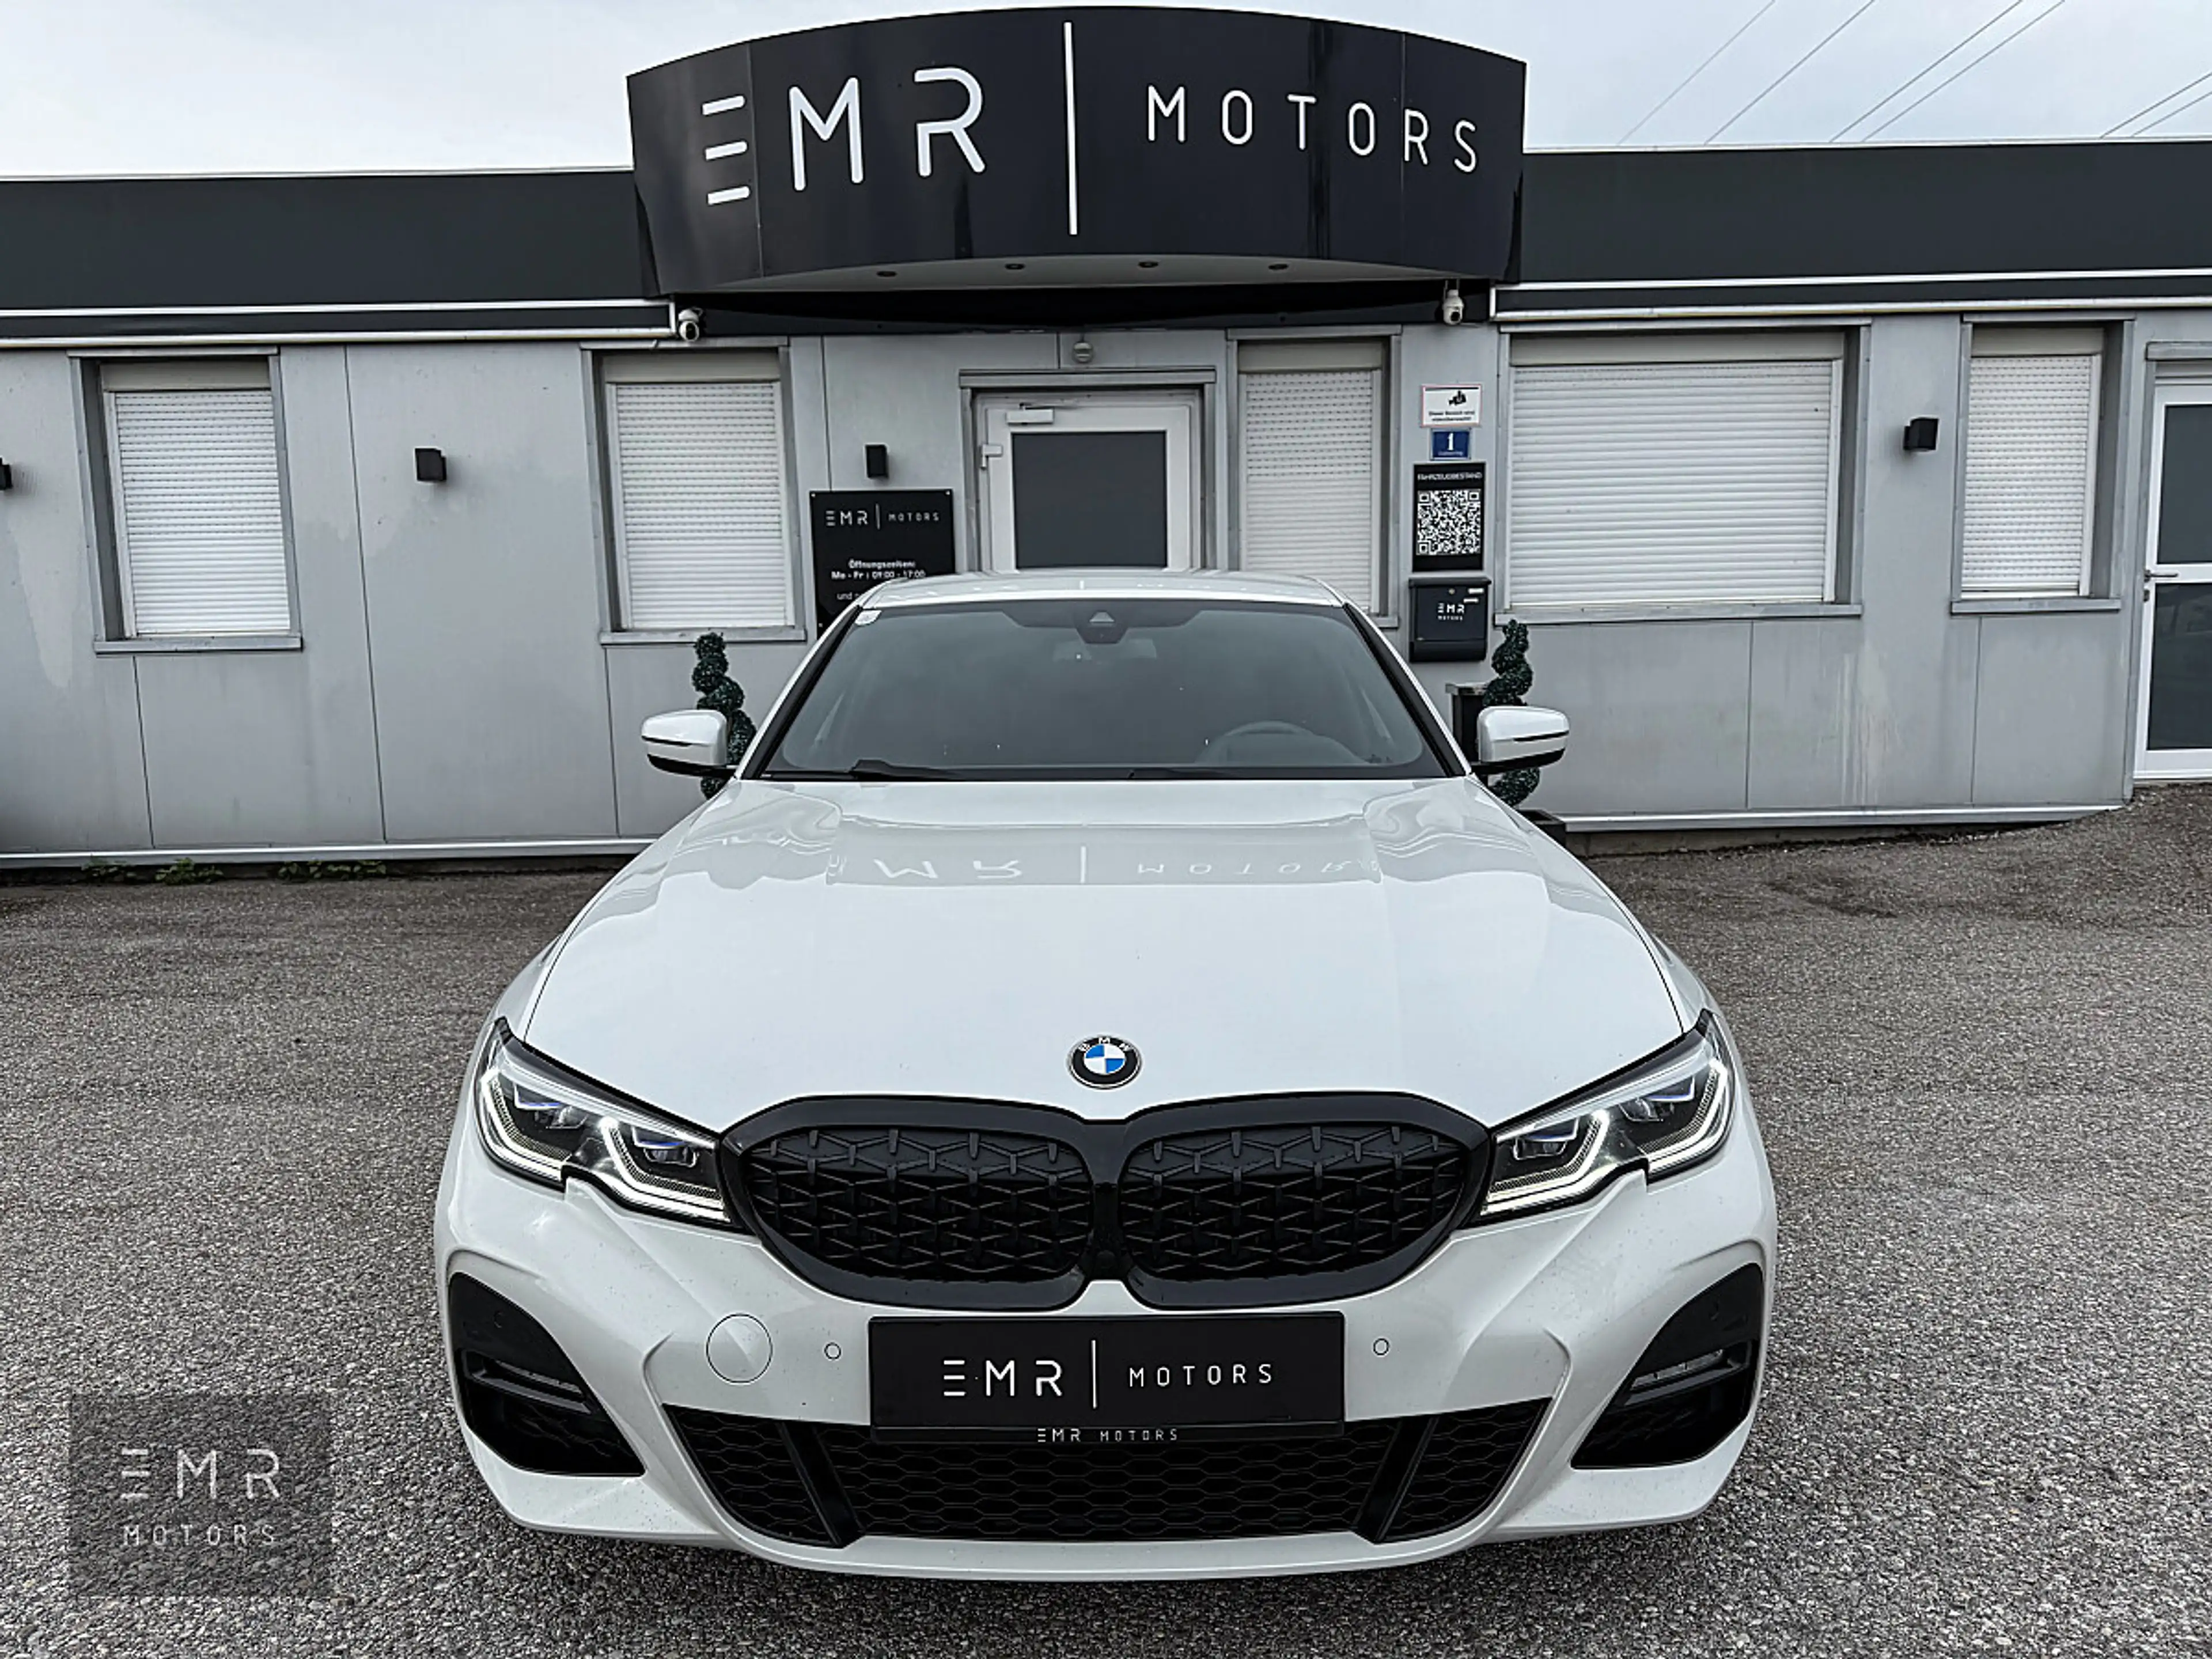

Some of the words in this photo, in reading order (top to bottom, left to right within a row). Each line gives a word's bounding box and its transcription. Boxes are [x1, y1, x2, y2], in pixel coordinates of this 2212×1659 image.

[702, 67, 986, 206] EMR
[1147, 85, 1477, 173] MOTORS
[1447, 432, 1454, 450] 1
[825, 510, 868, 527] EMR
[888, 512, 940, 522] MOTORS
[836, 592, 853, 600] und
[1437, 603, 1465, 614] EMR
[943, 1359, 1063, 1396] EMR
[1128, 1363, 1272, 1388] MOTORS
[1037, 1428, 1081, 1442] EMR
[1100, 1428, 1177, 1442] MOTORS
